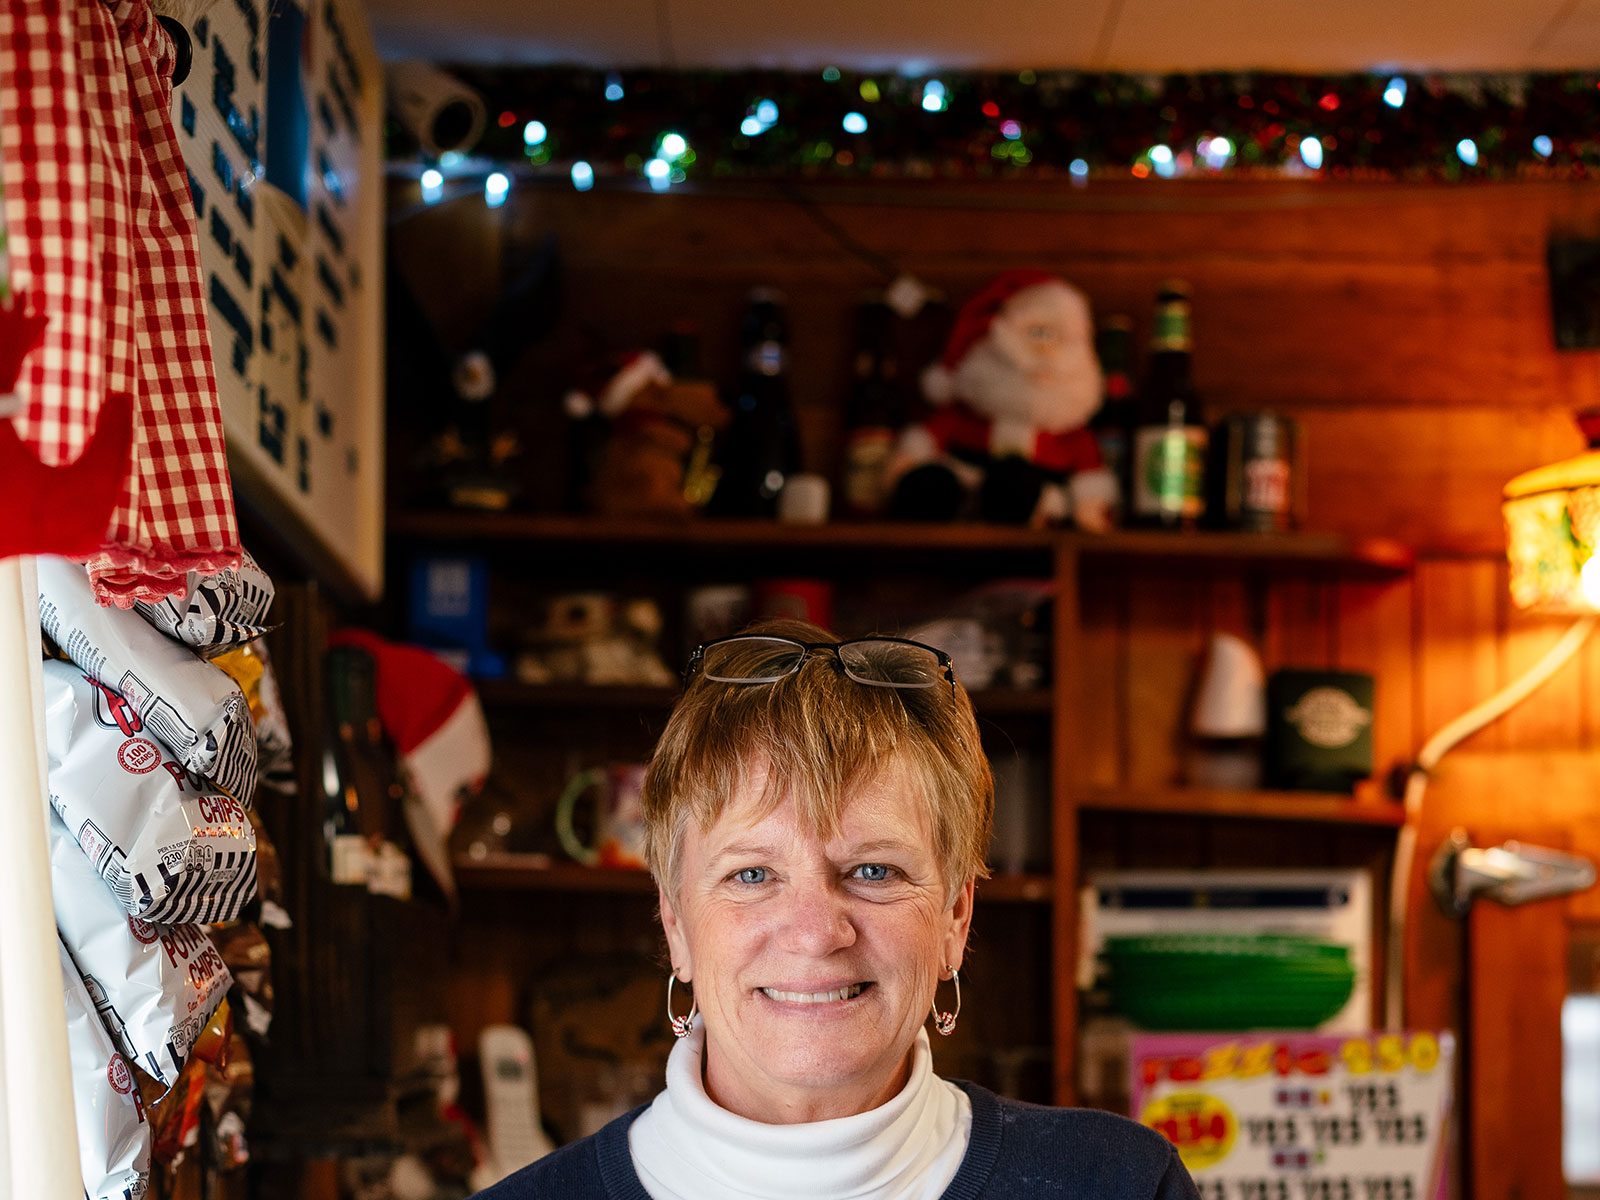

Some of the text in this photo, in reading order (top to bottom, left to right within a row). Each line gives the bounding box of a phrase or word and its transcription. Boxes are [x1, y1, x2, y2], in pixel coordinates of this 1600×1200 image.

[126, 744, 147, 761] 100
[132, 751, 154, 768] YEARS
[199, 796, 244, 824] CHIPS
[157, 846, 169, 855] PER
[164, 851, 182, 866] 230
[189, 946, 223, 990] CHIPS
[114, 1062, 126, 1077] 100
[1347, 1081, 1400, 1112] YES
[1246, 1112, 1427, 1145] YES YES YES
